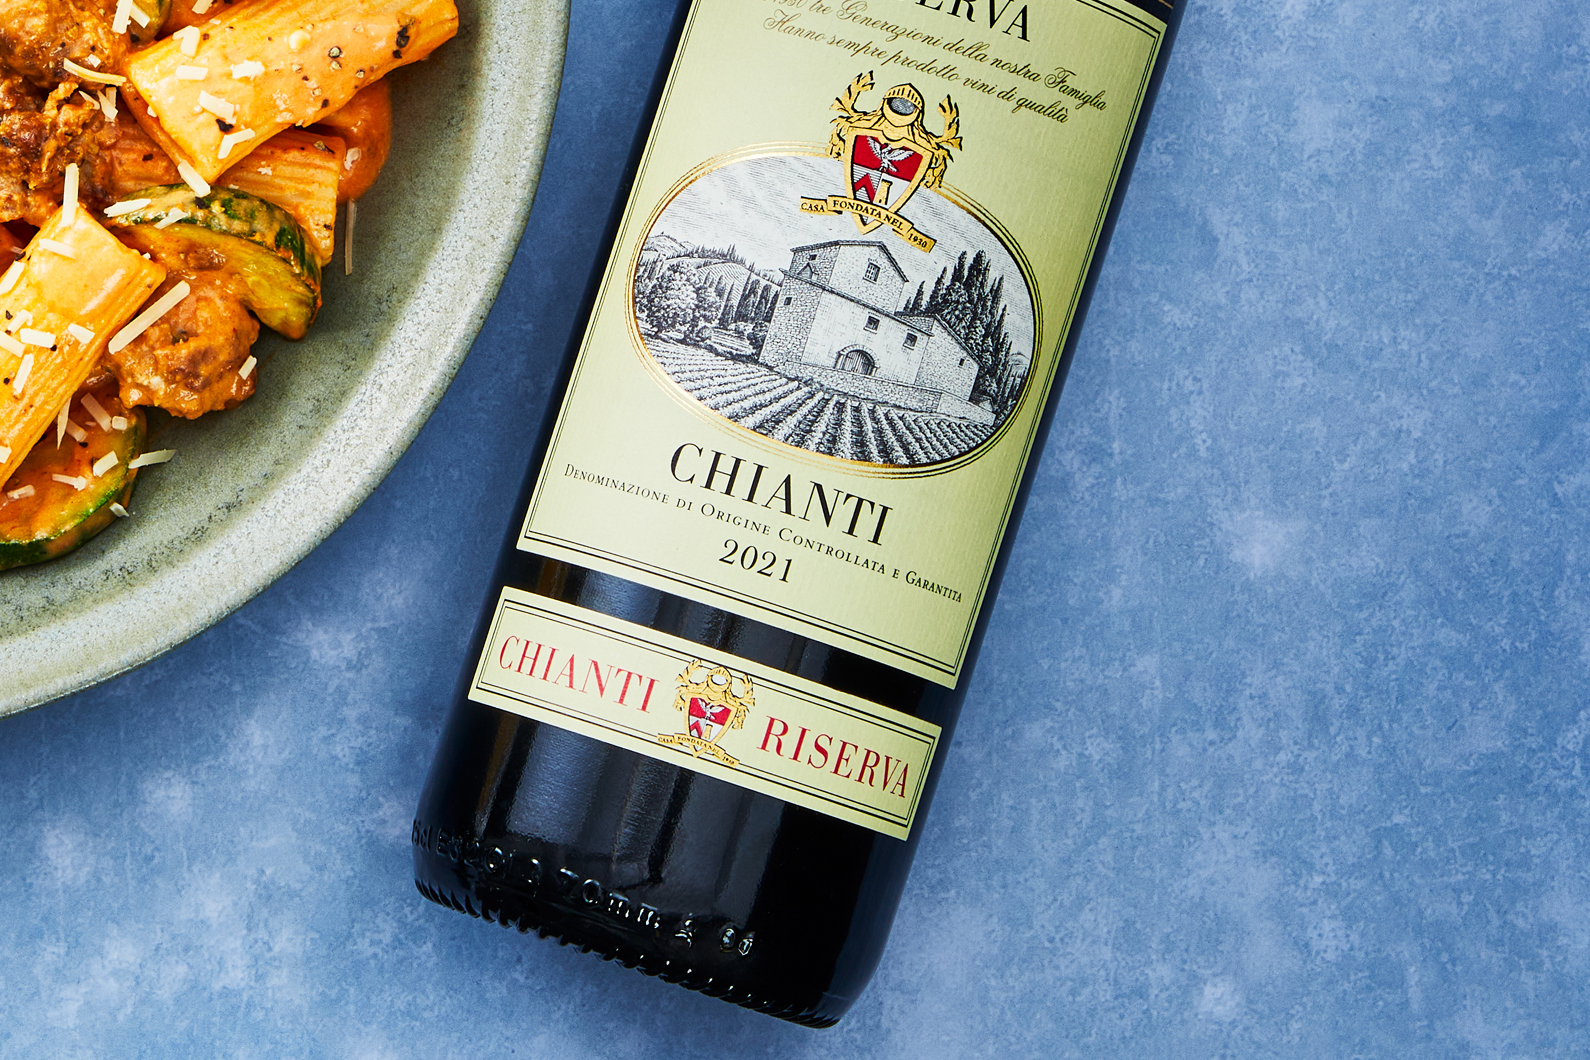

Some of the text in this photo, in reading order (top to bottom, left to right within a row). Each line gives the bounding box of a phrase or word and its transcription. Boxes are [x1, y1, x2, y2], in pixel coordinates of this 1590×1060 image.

[763, 9, 1068, 123] Hanno sempre prodotto vini di qualità
[837, 0, 944, 47] Generazioni
[942, 38, 990, 63] della
[990, 57, 1042, 83] nostra
[1044, 67, 1107, 111] Famiglia
[800, 199, 928, 249] CASA FONDATA NEL 1930
[670, 442, 893, 546] CHIANTI
[675, 498, 694, 511] DI
[700, 502, 771, 535] ORIGINE
[891, 568, 900, 579] E
[905, 570, 962, 603] GARANTITA
[718, 538, 793, 584] 2021
[498, 635, 912, 799] CHIANTI RISERVA
